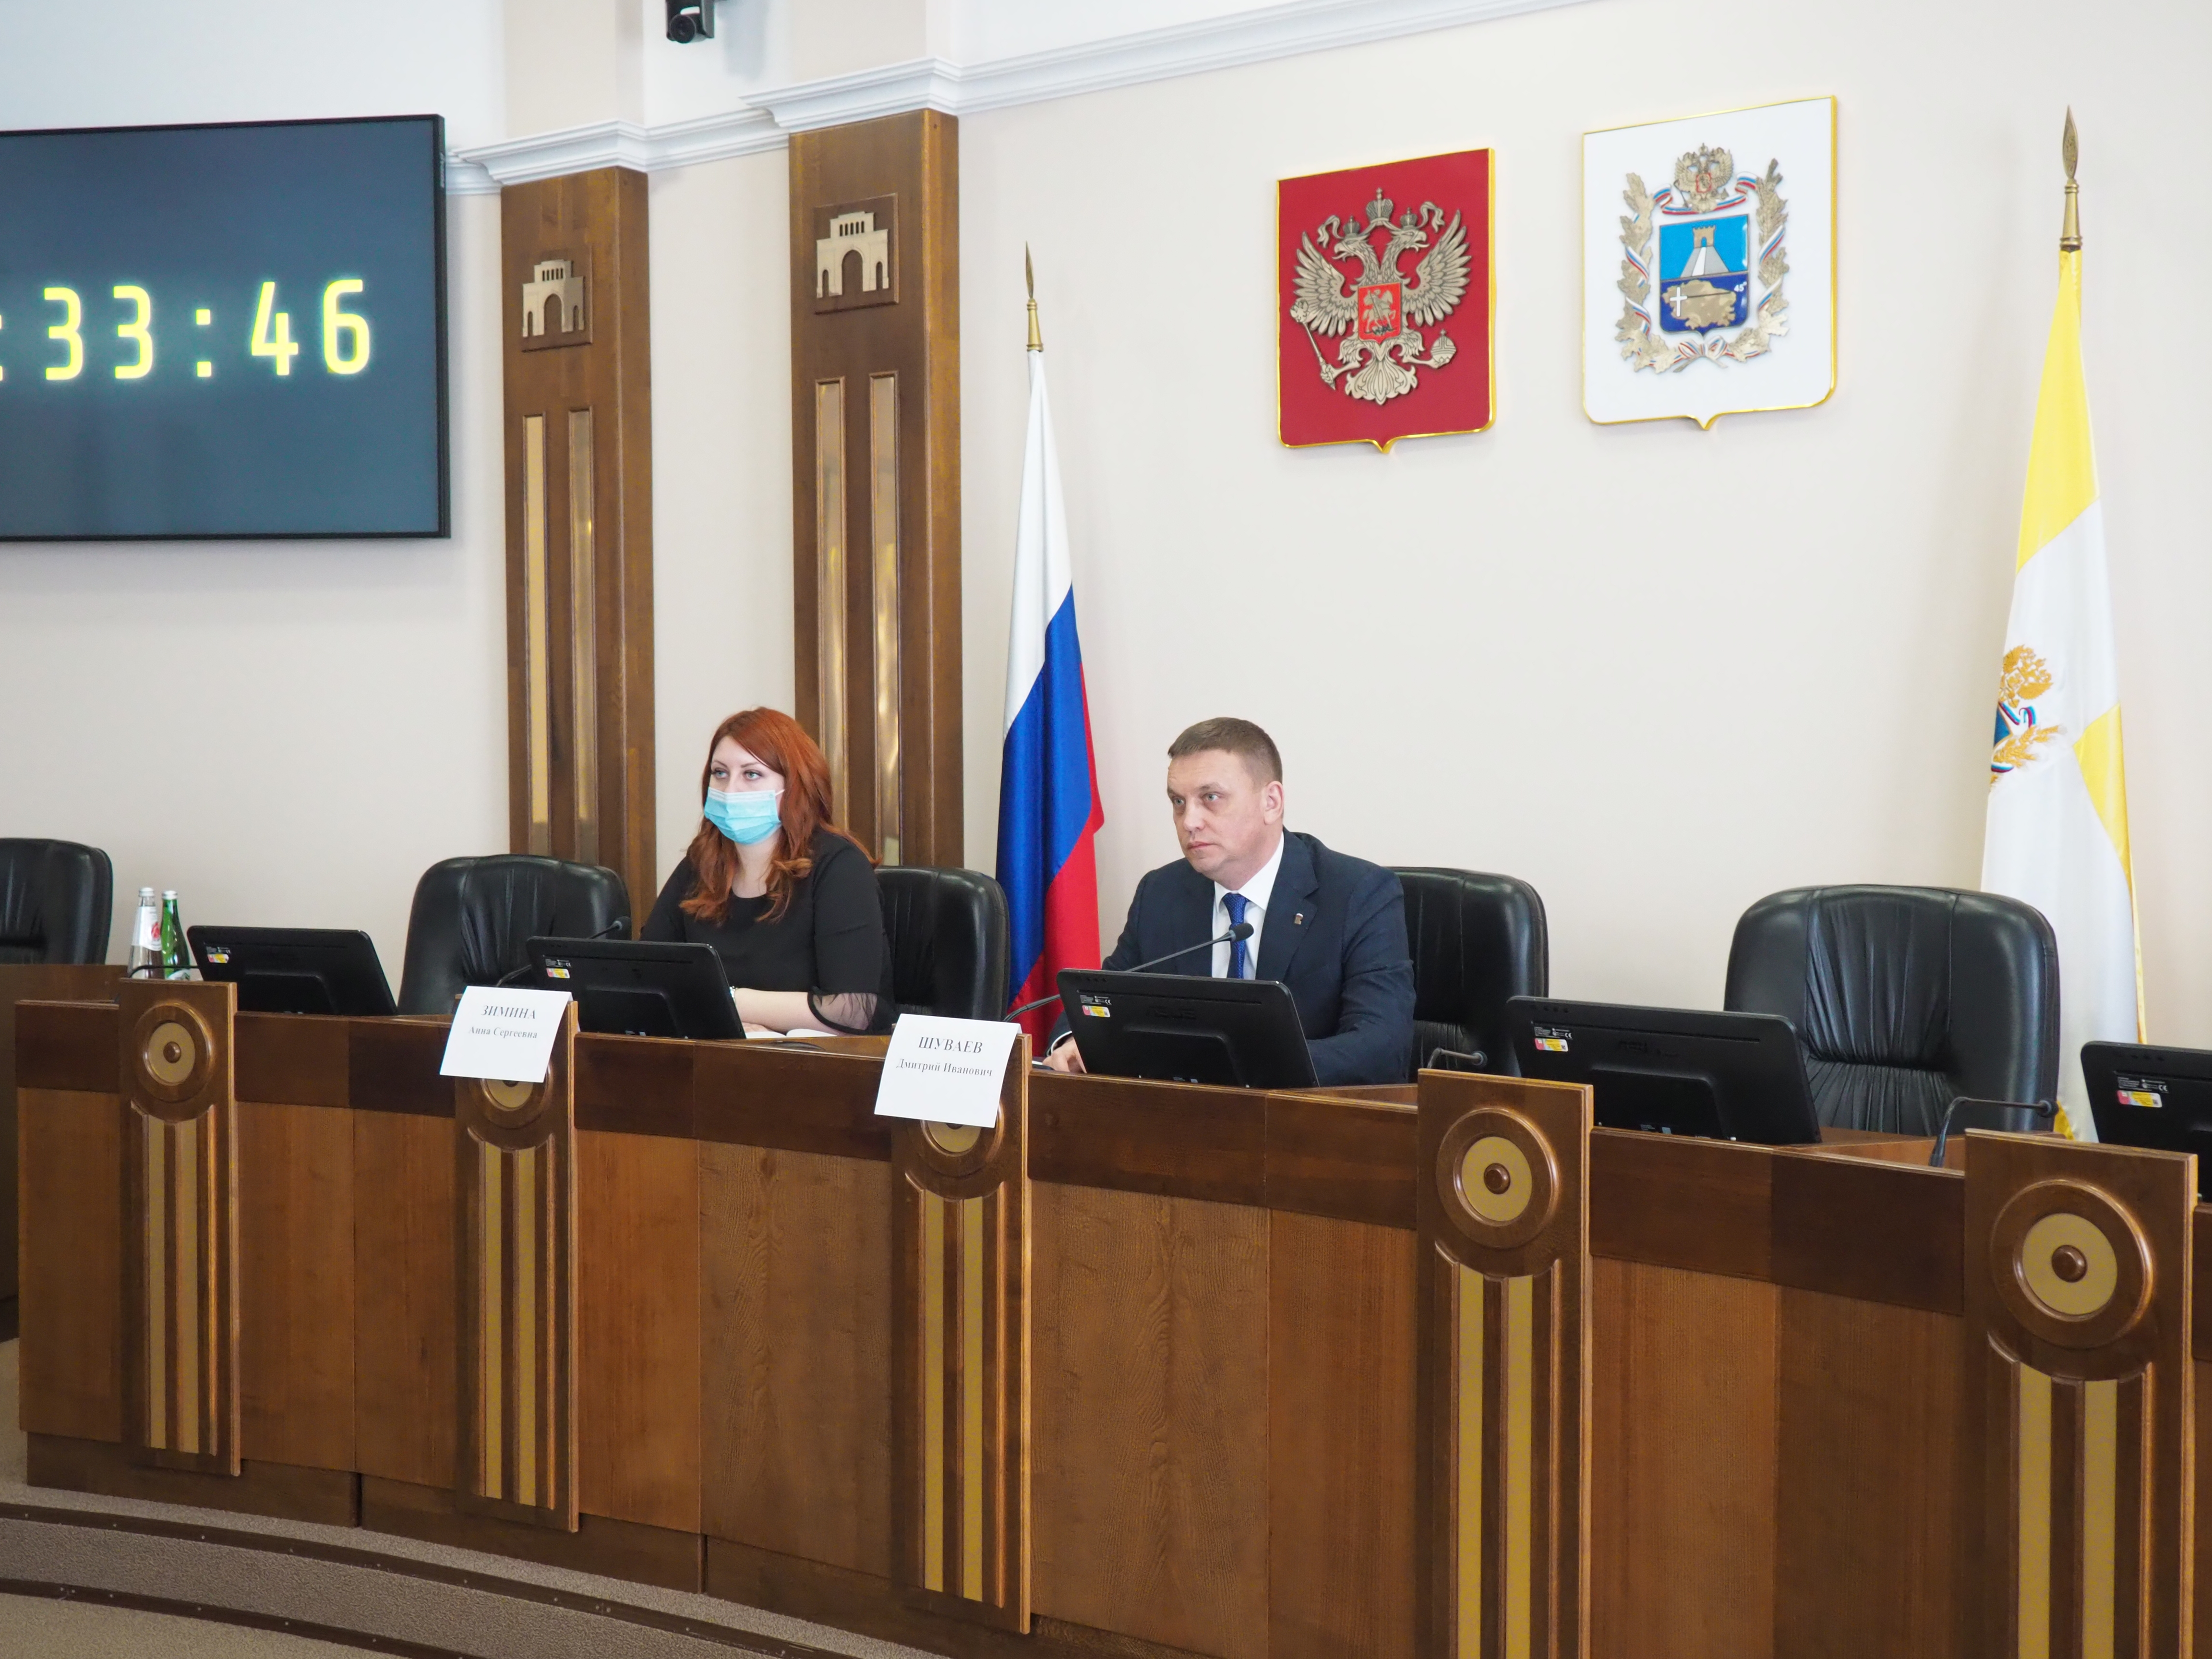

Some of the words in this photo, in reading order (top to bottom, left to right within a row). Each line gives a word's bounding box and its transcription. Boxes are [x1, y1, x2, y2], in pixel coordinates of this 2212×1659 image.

[0, 279, 371, 381] 33:46
[481, 1005, 536, 1019] ЗИМИНА
[469, 1026, 491, 1035] Анна
[493, 1027, 537, 1038] Сергеевна
[918, 1037, 983, 1053] ШУВАЕВ
[896, 1058, 940, 1072] Дмитрий
[943, 1063, 992, 1076] Иванович
